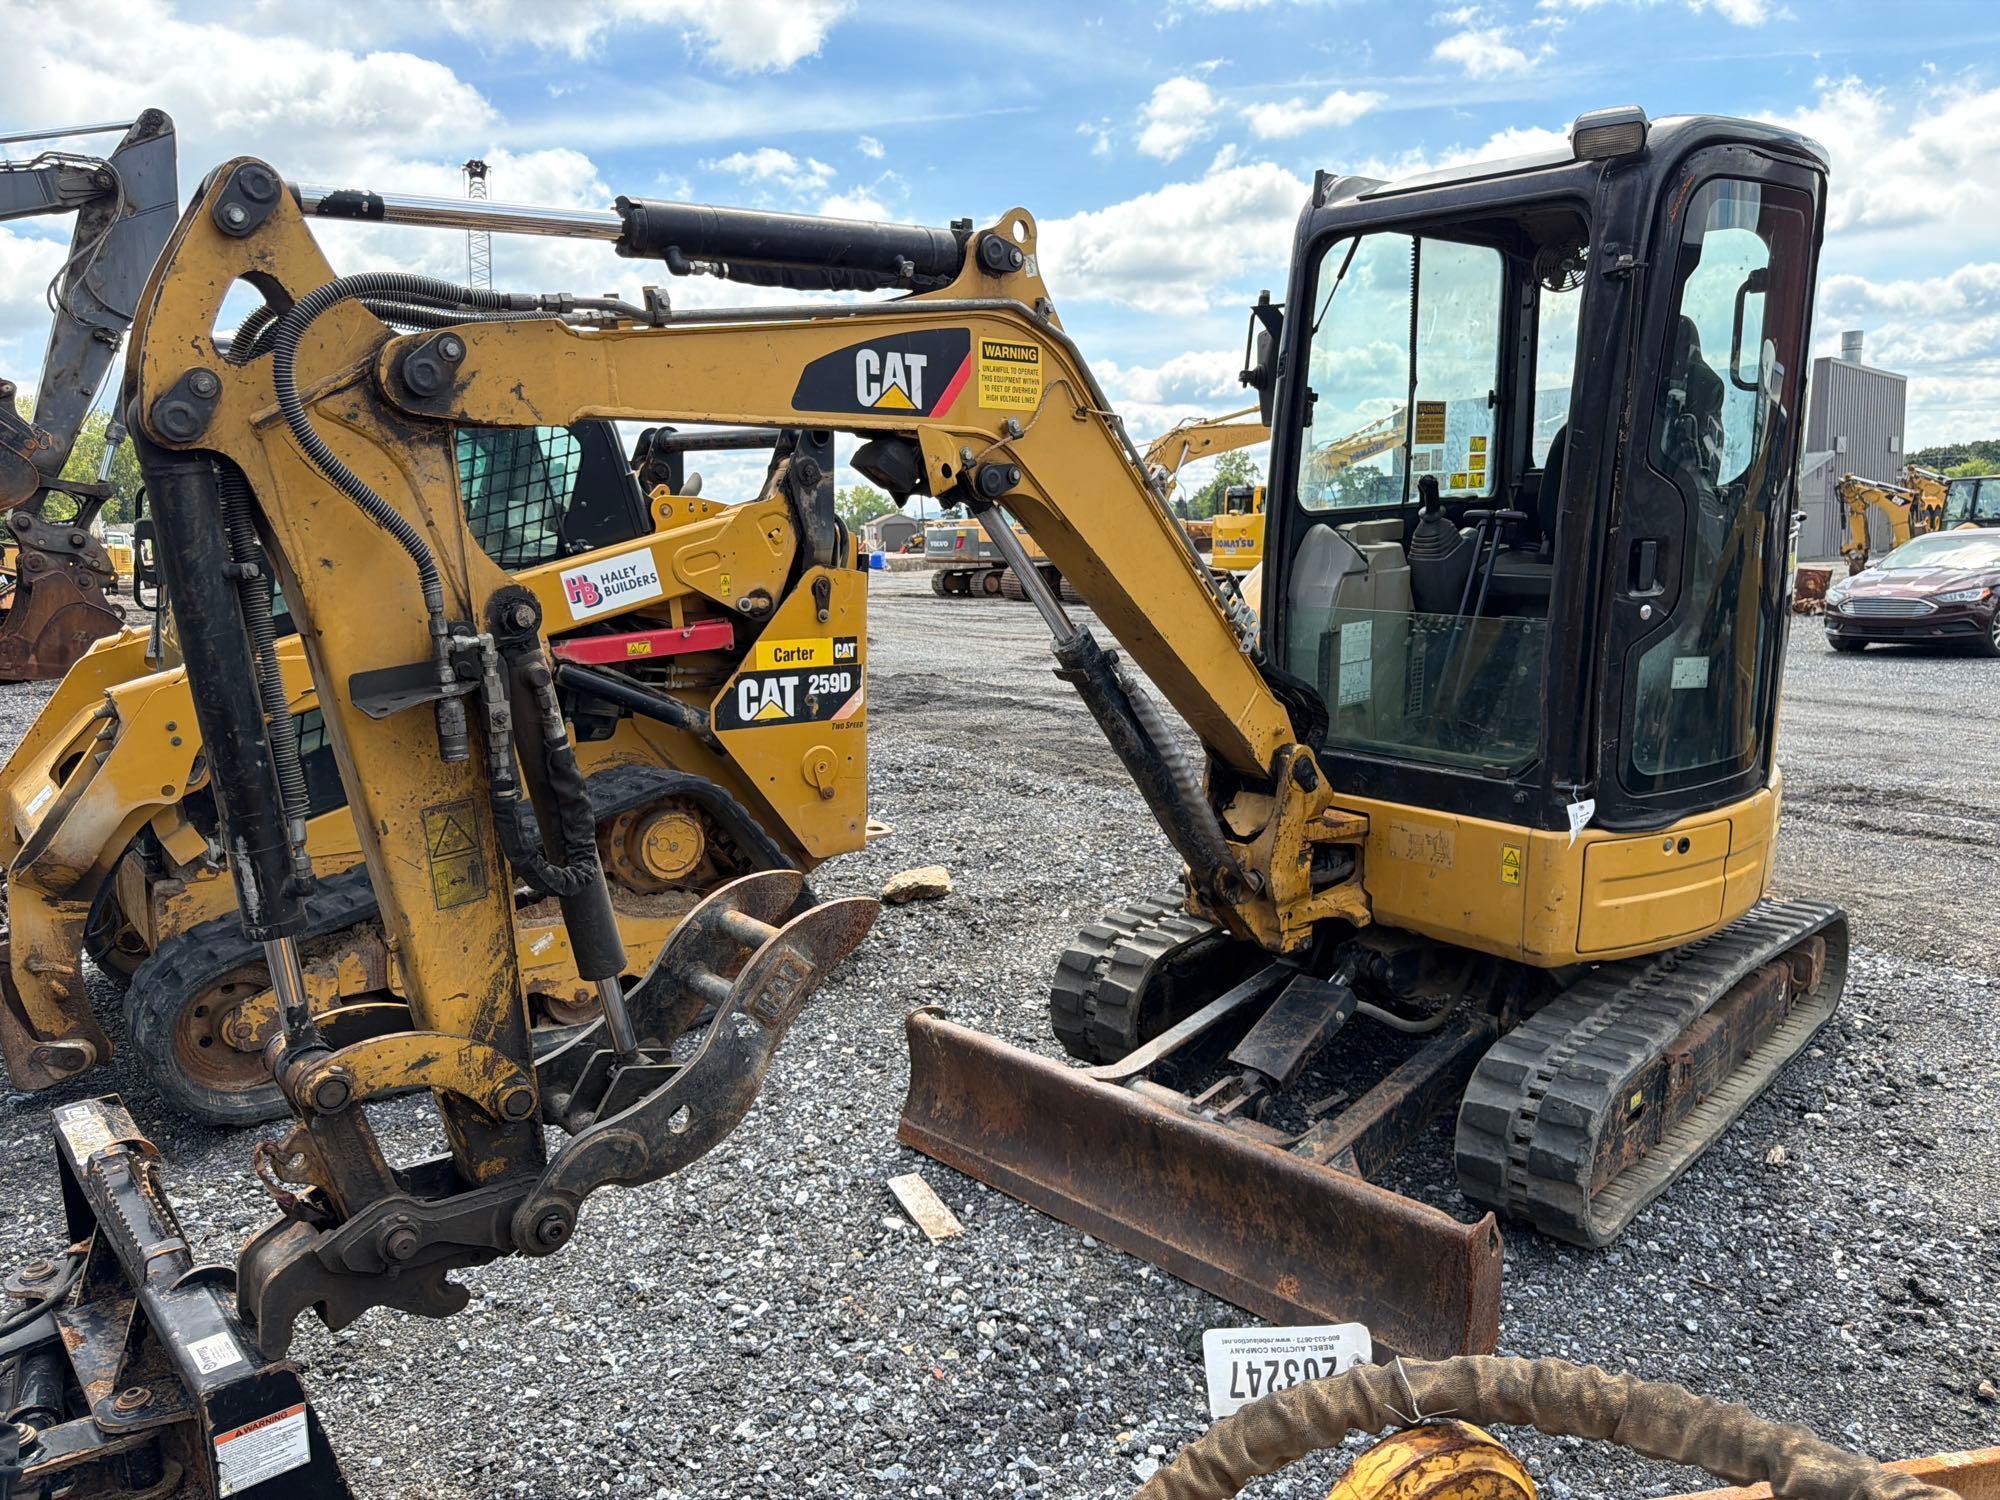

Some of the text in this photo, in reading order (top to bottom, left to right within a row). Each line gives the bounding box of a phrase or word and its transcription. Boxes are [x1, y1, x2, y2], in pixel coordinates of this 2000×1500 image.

[984, 344, 1037, 361] WARNING
[982, 365, 1010, 374] UNLAWFUL
[1018, 367, 1039, 376] OPERATE
[856, 349, 927, 410] CAT
[981, 374, 1040, 386] THIS EQUIPMENT WITHIN
[1012, 386, 1038, 395] OVERHEAD
[986, 394, 1036, 404] HIGH VOLTAGE LINES
[1215, 538, 1254, 548] KOMATSU
[600, 565, 636, 585] HALEY
[565, 575, 603, 608] HB
[604, 572, 657, 597] BUILDERS
[774, 647, 814, 662] Carter
[835, 643, 856, 659] CAT
[808, 672, 851, 695] 259D
[738, 676, 799, 721] CAT
[1229, 1343, 1334, 1355] REBEL AUCTION COMPANY
[244, 1411, 288, 1434] WARNING
